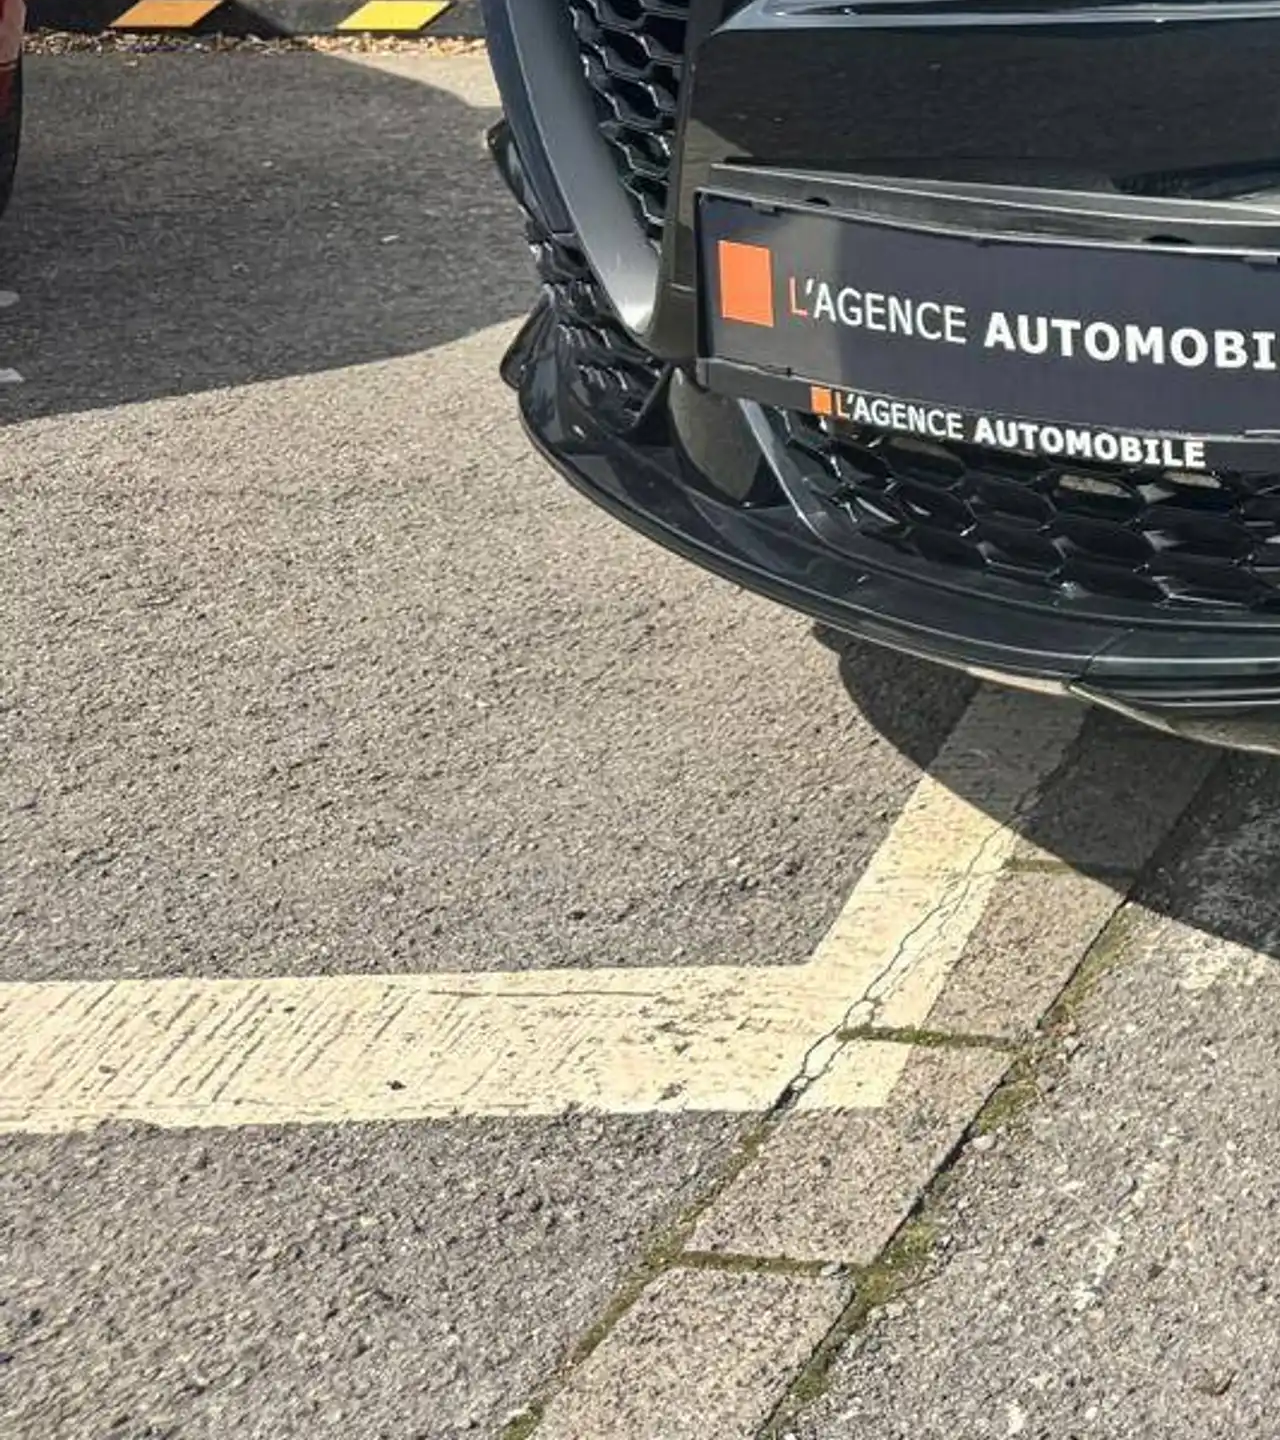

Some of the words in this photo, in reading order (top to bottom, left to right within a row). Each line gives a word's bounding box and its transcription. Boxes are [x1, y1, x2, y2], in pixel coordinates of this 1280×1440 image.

[789, 275, 968, 344] L'AGENCE
[834, 390, 966, 440] L'AGENCE
[973, 417, 1207, 469] AUTOMOBILE
